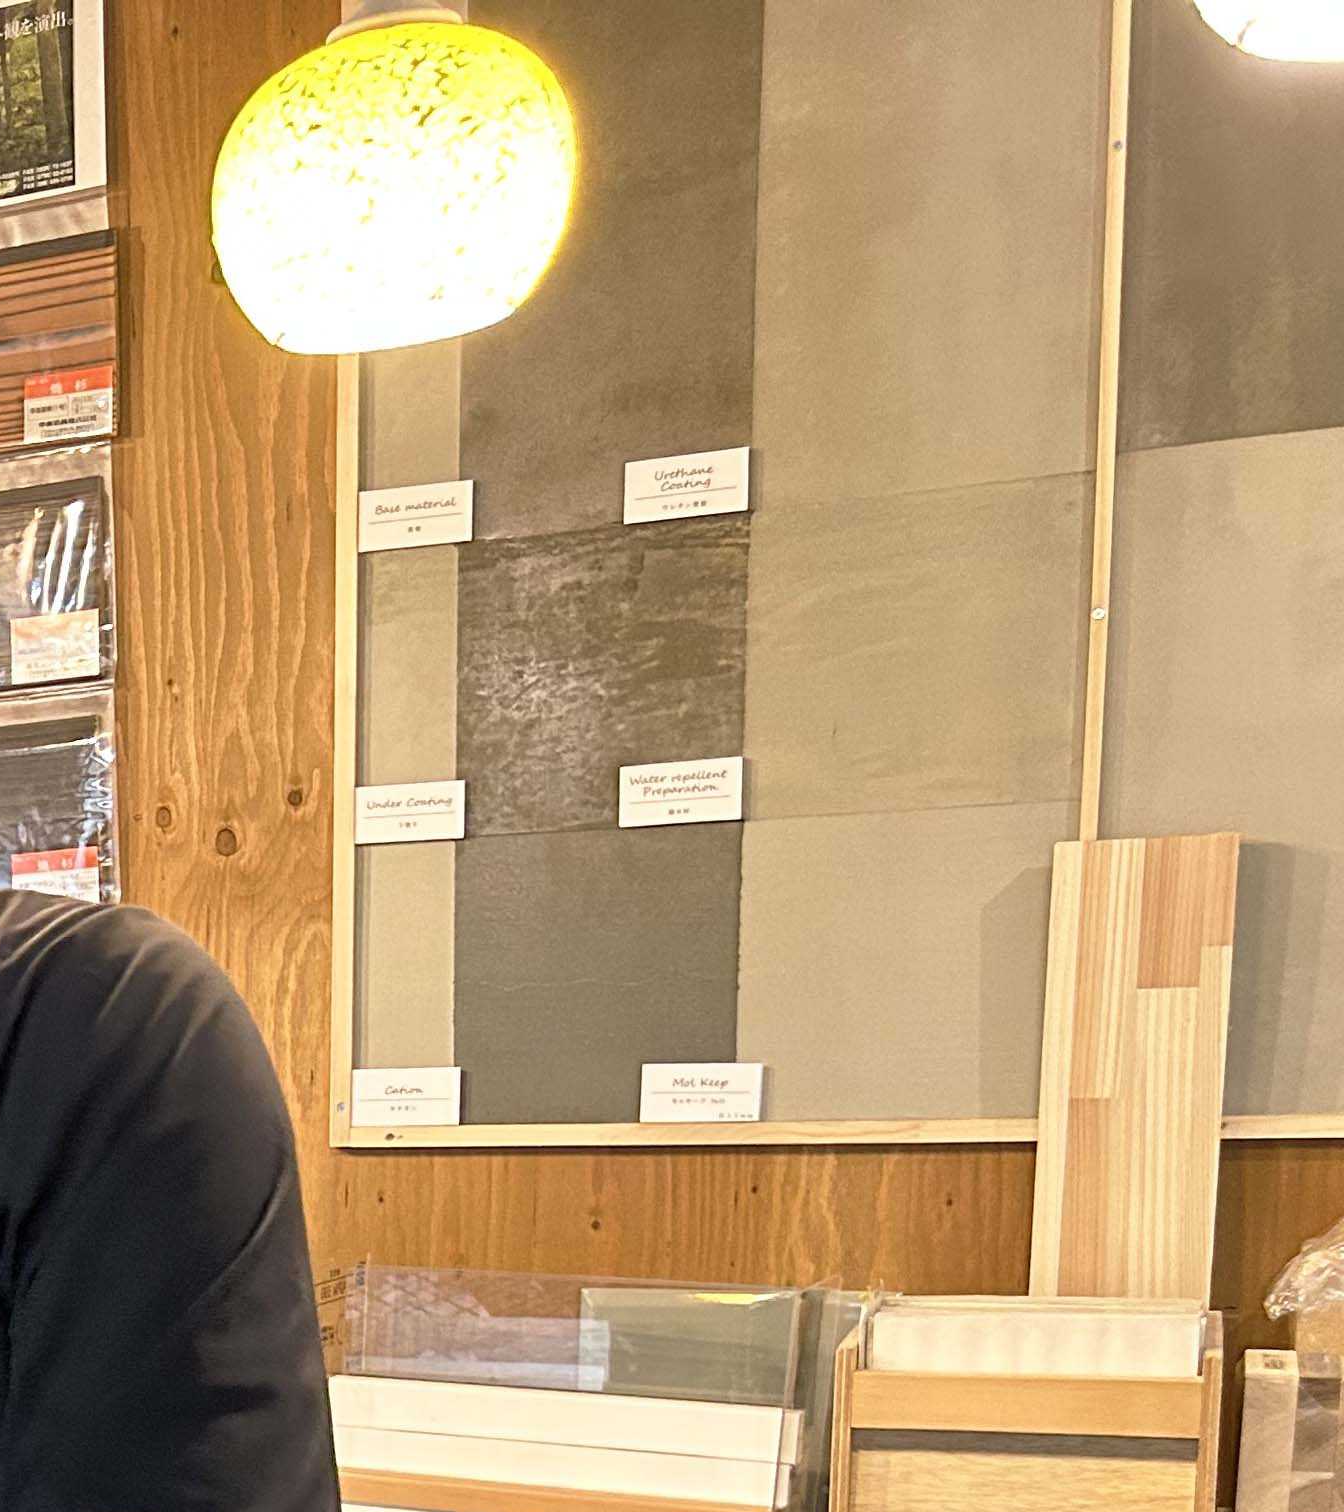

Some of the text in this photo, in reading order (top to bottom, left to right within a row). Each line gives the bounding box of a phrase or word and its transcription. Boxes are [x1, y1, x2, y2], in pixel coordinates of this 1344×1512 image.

[660, 477, 711, 492] Coating
[374, 496, 457, 516] Base material
